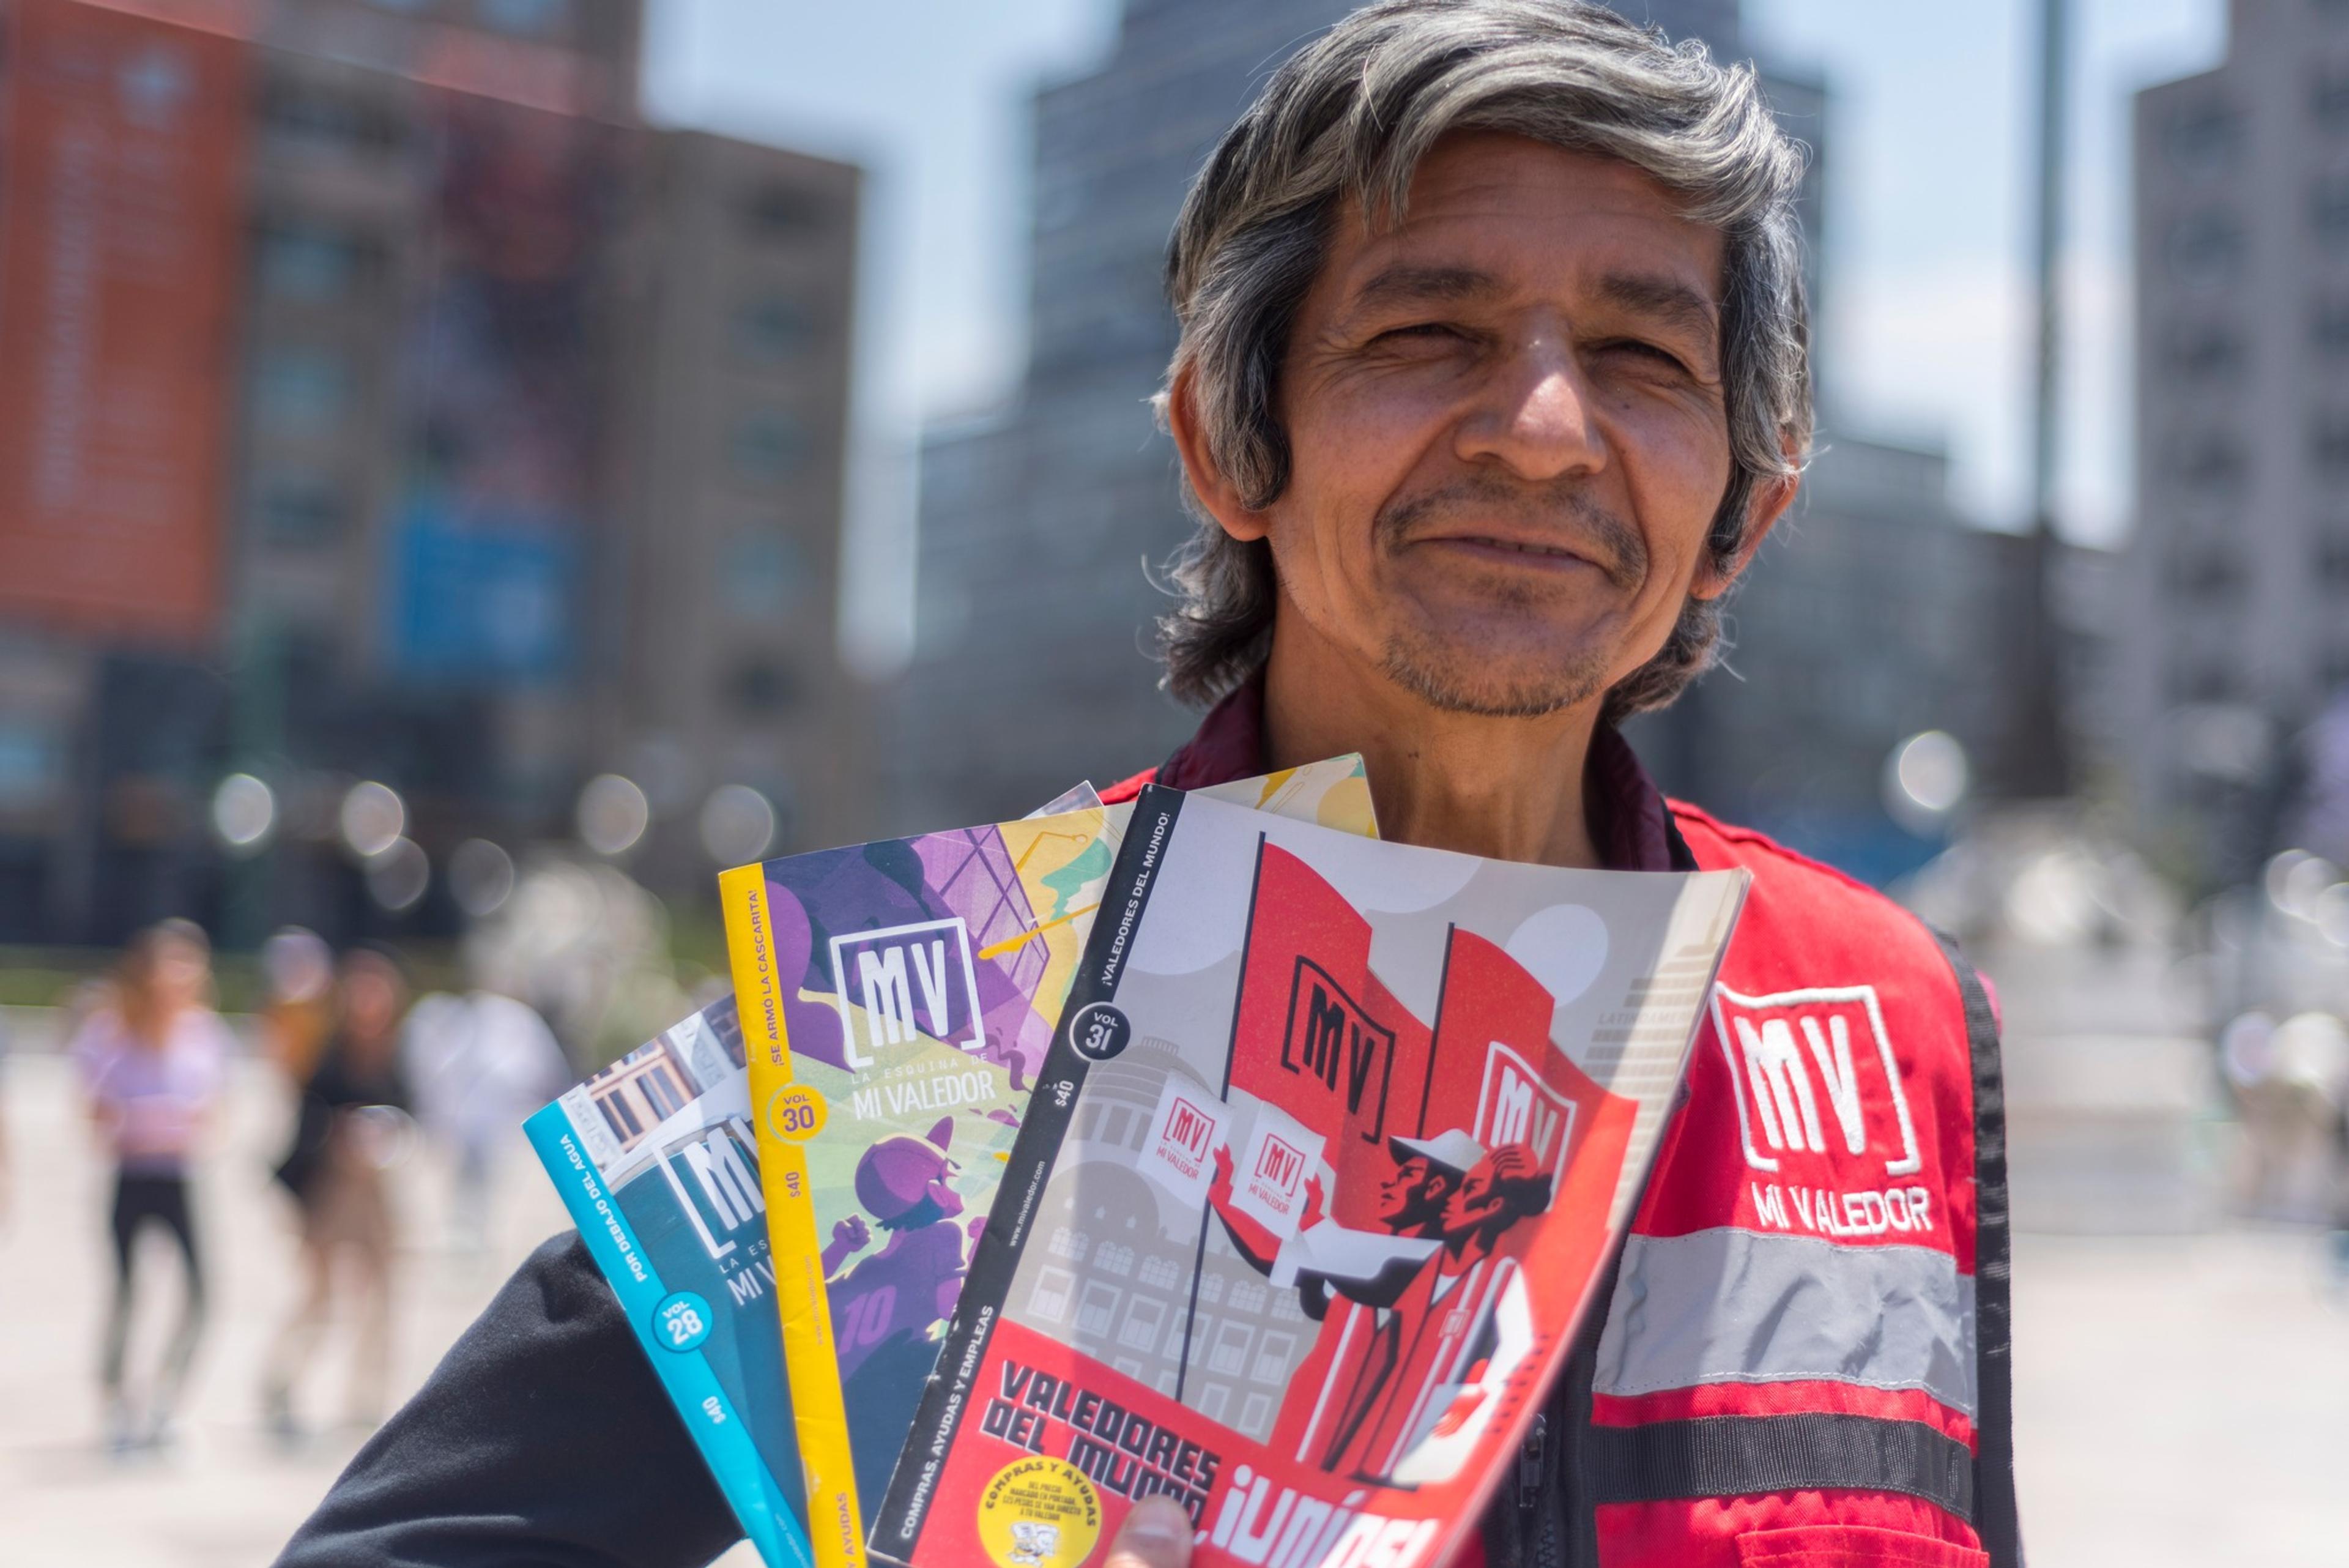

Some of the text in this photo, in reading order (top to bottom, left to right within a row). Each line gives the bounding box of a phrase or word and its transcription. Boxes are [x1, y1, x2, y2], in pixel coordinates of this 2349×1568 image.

[1101, 812, 1170, 987] ¡VALEDORES DEL MUNDO!
[748, 890, 768, 972] CASCARITA!
[760, 975, 772, 995] LA
[858, 940, 948, 1047] MV
[1085, 1024, 1113, 1051] 31
[1094, 1012, 1118, 1027] VOL
[852, 1053, 988, 1084] LA ESQUINA DE
[1303, 982, 1375, 1115] MV
[783, 1094, 810, 1104] VOL
[852, 1070, 996, 1121] MI VALEDOR
[1055, 1080, 1074, 1107] $40
[1733, 1015, 1866, 1155] MV
[782, 1105, 815, 1132] 30
[1172, 1107, 1206, 1151] MV
[785, 1172, 801, 1197] $40
[1167, 1151, 1199, 1180] VALEDOR
[1264, 1143, 1297, 1187] MV
[560, 1134, 648, 1282] POR DEBAJO DEL AGUA
[1010, 1161, 1045, 1247] www.mivaledor.com
[1751, 1182, 1933, 1236] MI VALEDOR
[719, 1258, 739, 1274] LA
[727, 1268, 763, 1306] MI
[662, 1300, 690, 1318] VOL
[666, 1309, 703, 1345] 28
[838, 1285, 897, 1356] 10
[702, 1395, 727, 1424] $40
[900, 1305, 994, 1539] COMPRAS, AYUDAS Y EMPLEAS
[979, 1397, 1047, 1455] DEL
[1000, 1359, 1222, 1495] VALEDORES
[985, 1462, 1096, 1526] COMPRAS Y AYUDAS
[836, 1492, 855, 1555] AYUDAS
